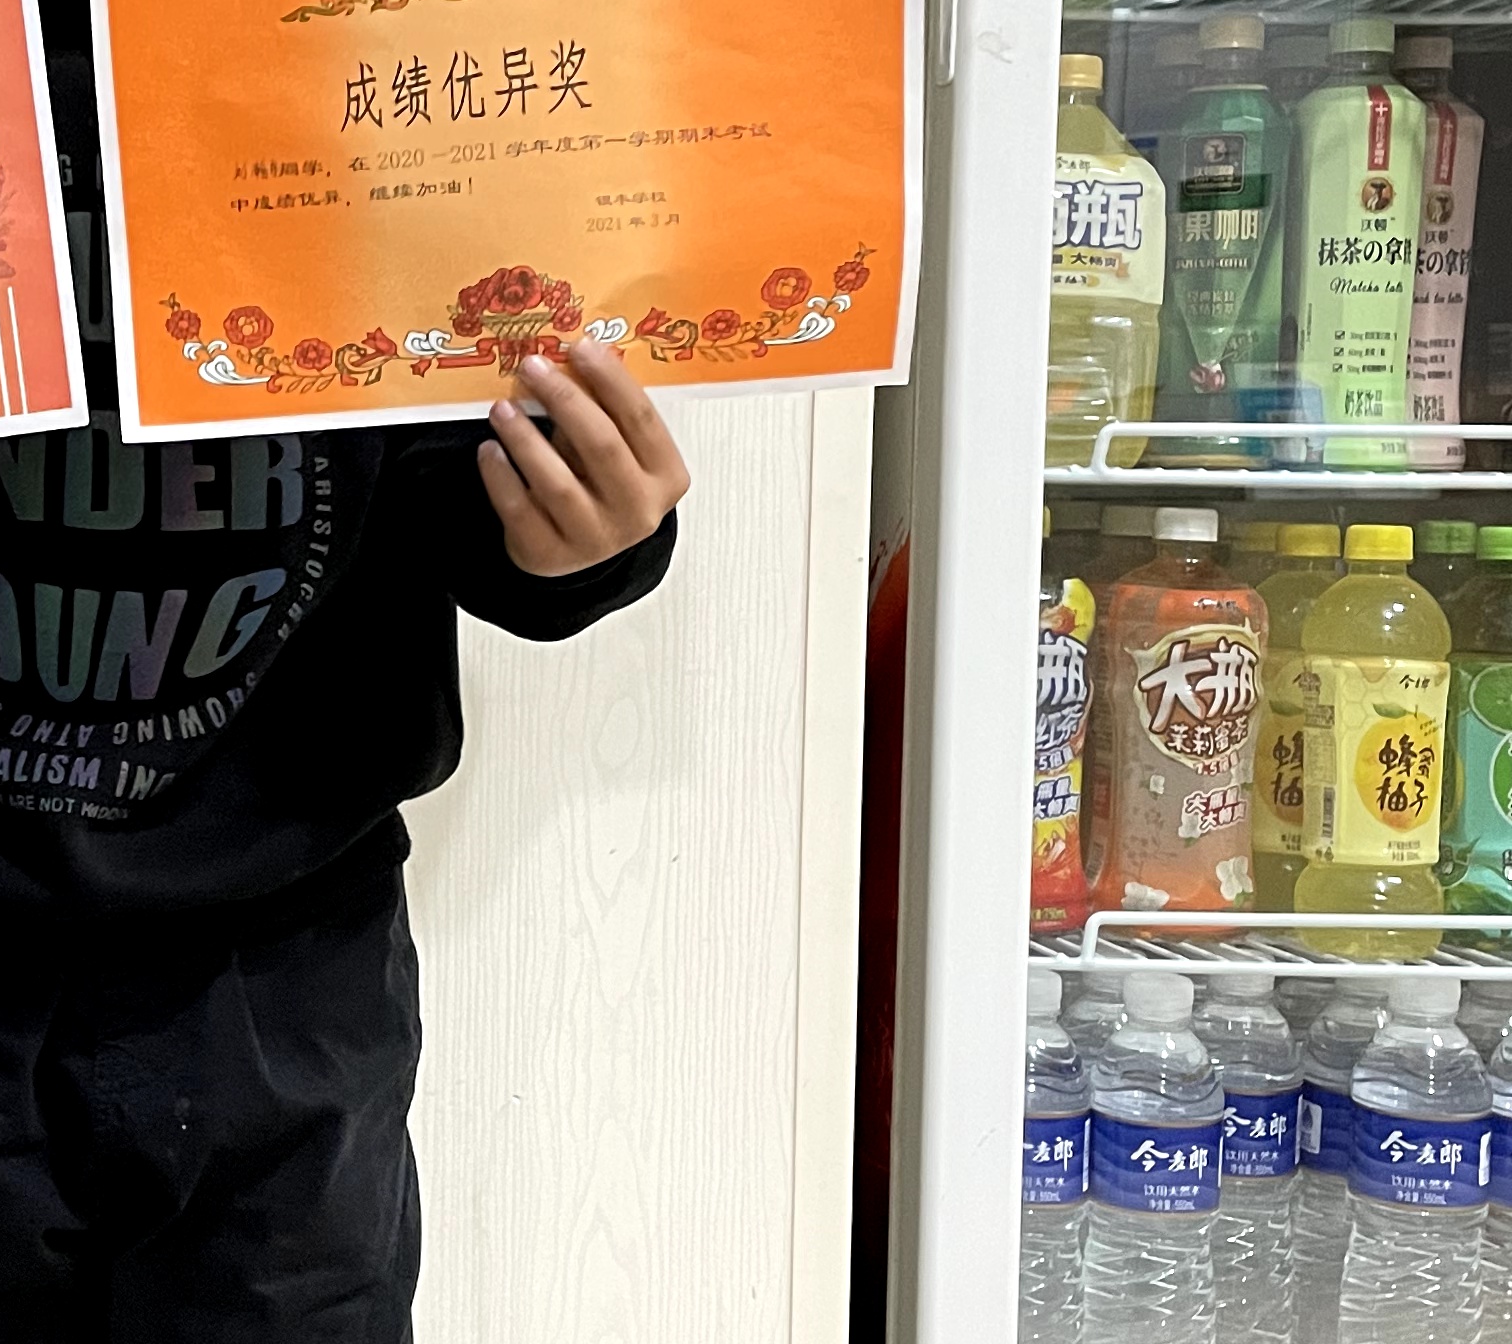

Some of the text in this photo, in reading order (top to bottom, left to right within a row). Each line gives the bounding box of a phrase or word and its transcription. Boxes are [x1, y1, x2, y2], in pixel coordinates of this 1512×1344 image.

[340, 38, 593, 133] 成绩优异奖
[1138, 635, 1259, 734] 大瓶
[1167, 716, 1250, 755] 茉莉蜜茶
[38, 797, 76, 814] NOT
[1376, 776, 1429, 818] 柚子
[1223, 1106, 1287, 1146] 今麦郎
[1023, 1137, 1074, 1172] 麦郎
[1130, 1139, 1208, 1180] 今麦郎
[1380, 1130, 1464, 1176] 今麦郎
